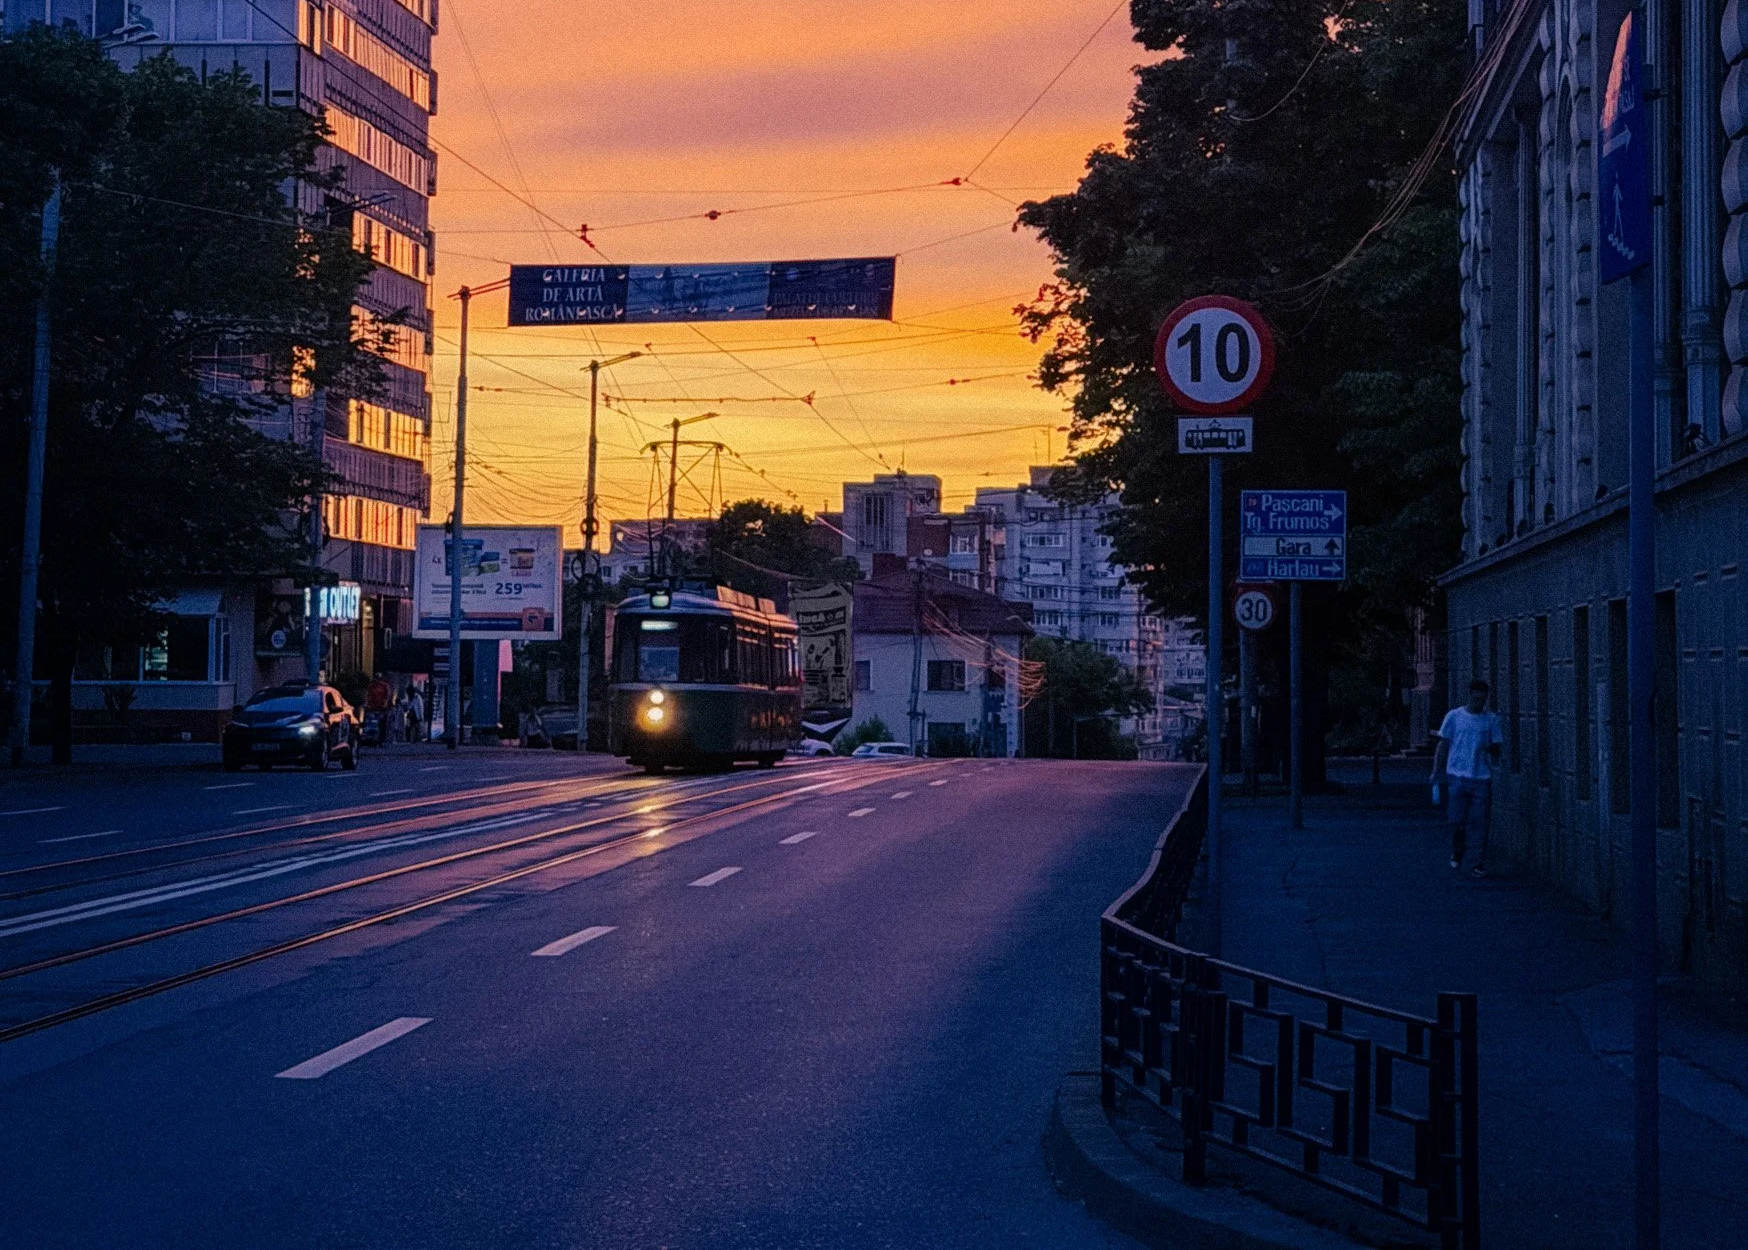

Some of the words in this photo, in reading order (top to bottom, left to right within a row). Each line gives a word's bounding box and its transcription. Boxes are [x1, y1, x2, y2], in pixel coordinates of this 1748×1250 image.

[542, 287, 563, 302] DE
[1176, 322, 1252, 384] 10
[1244, 511, 1265, 533] Tg.
[1269, 513, 1330, 530] Frumos
[1275, 537, 1312, 556] Gara
[495, 582, 523, 595] 259
[1241, 598, 1267, 622] 30
